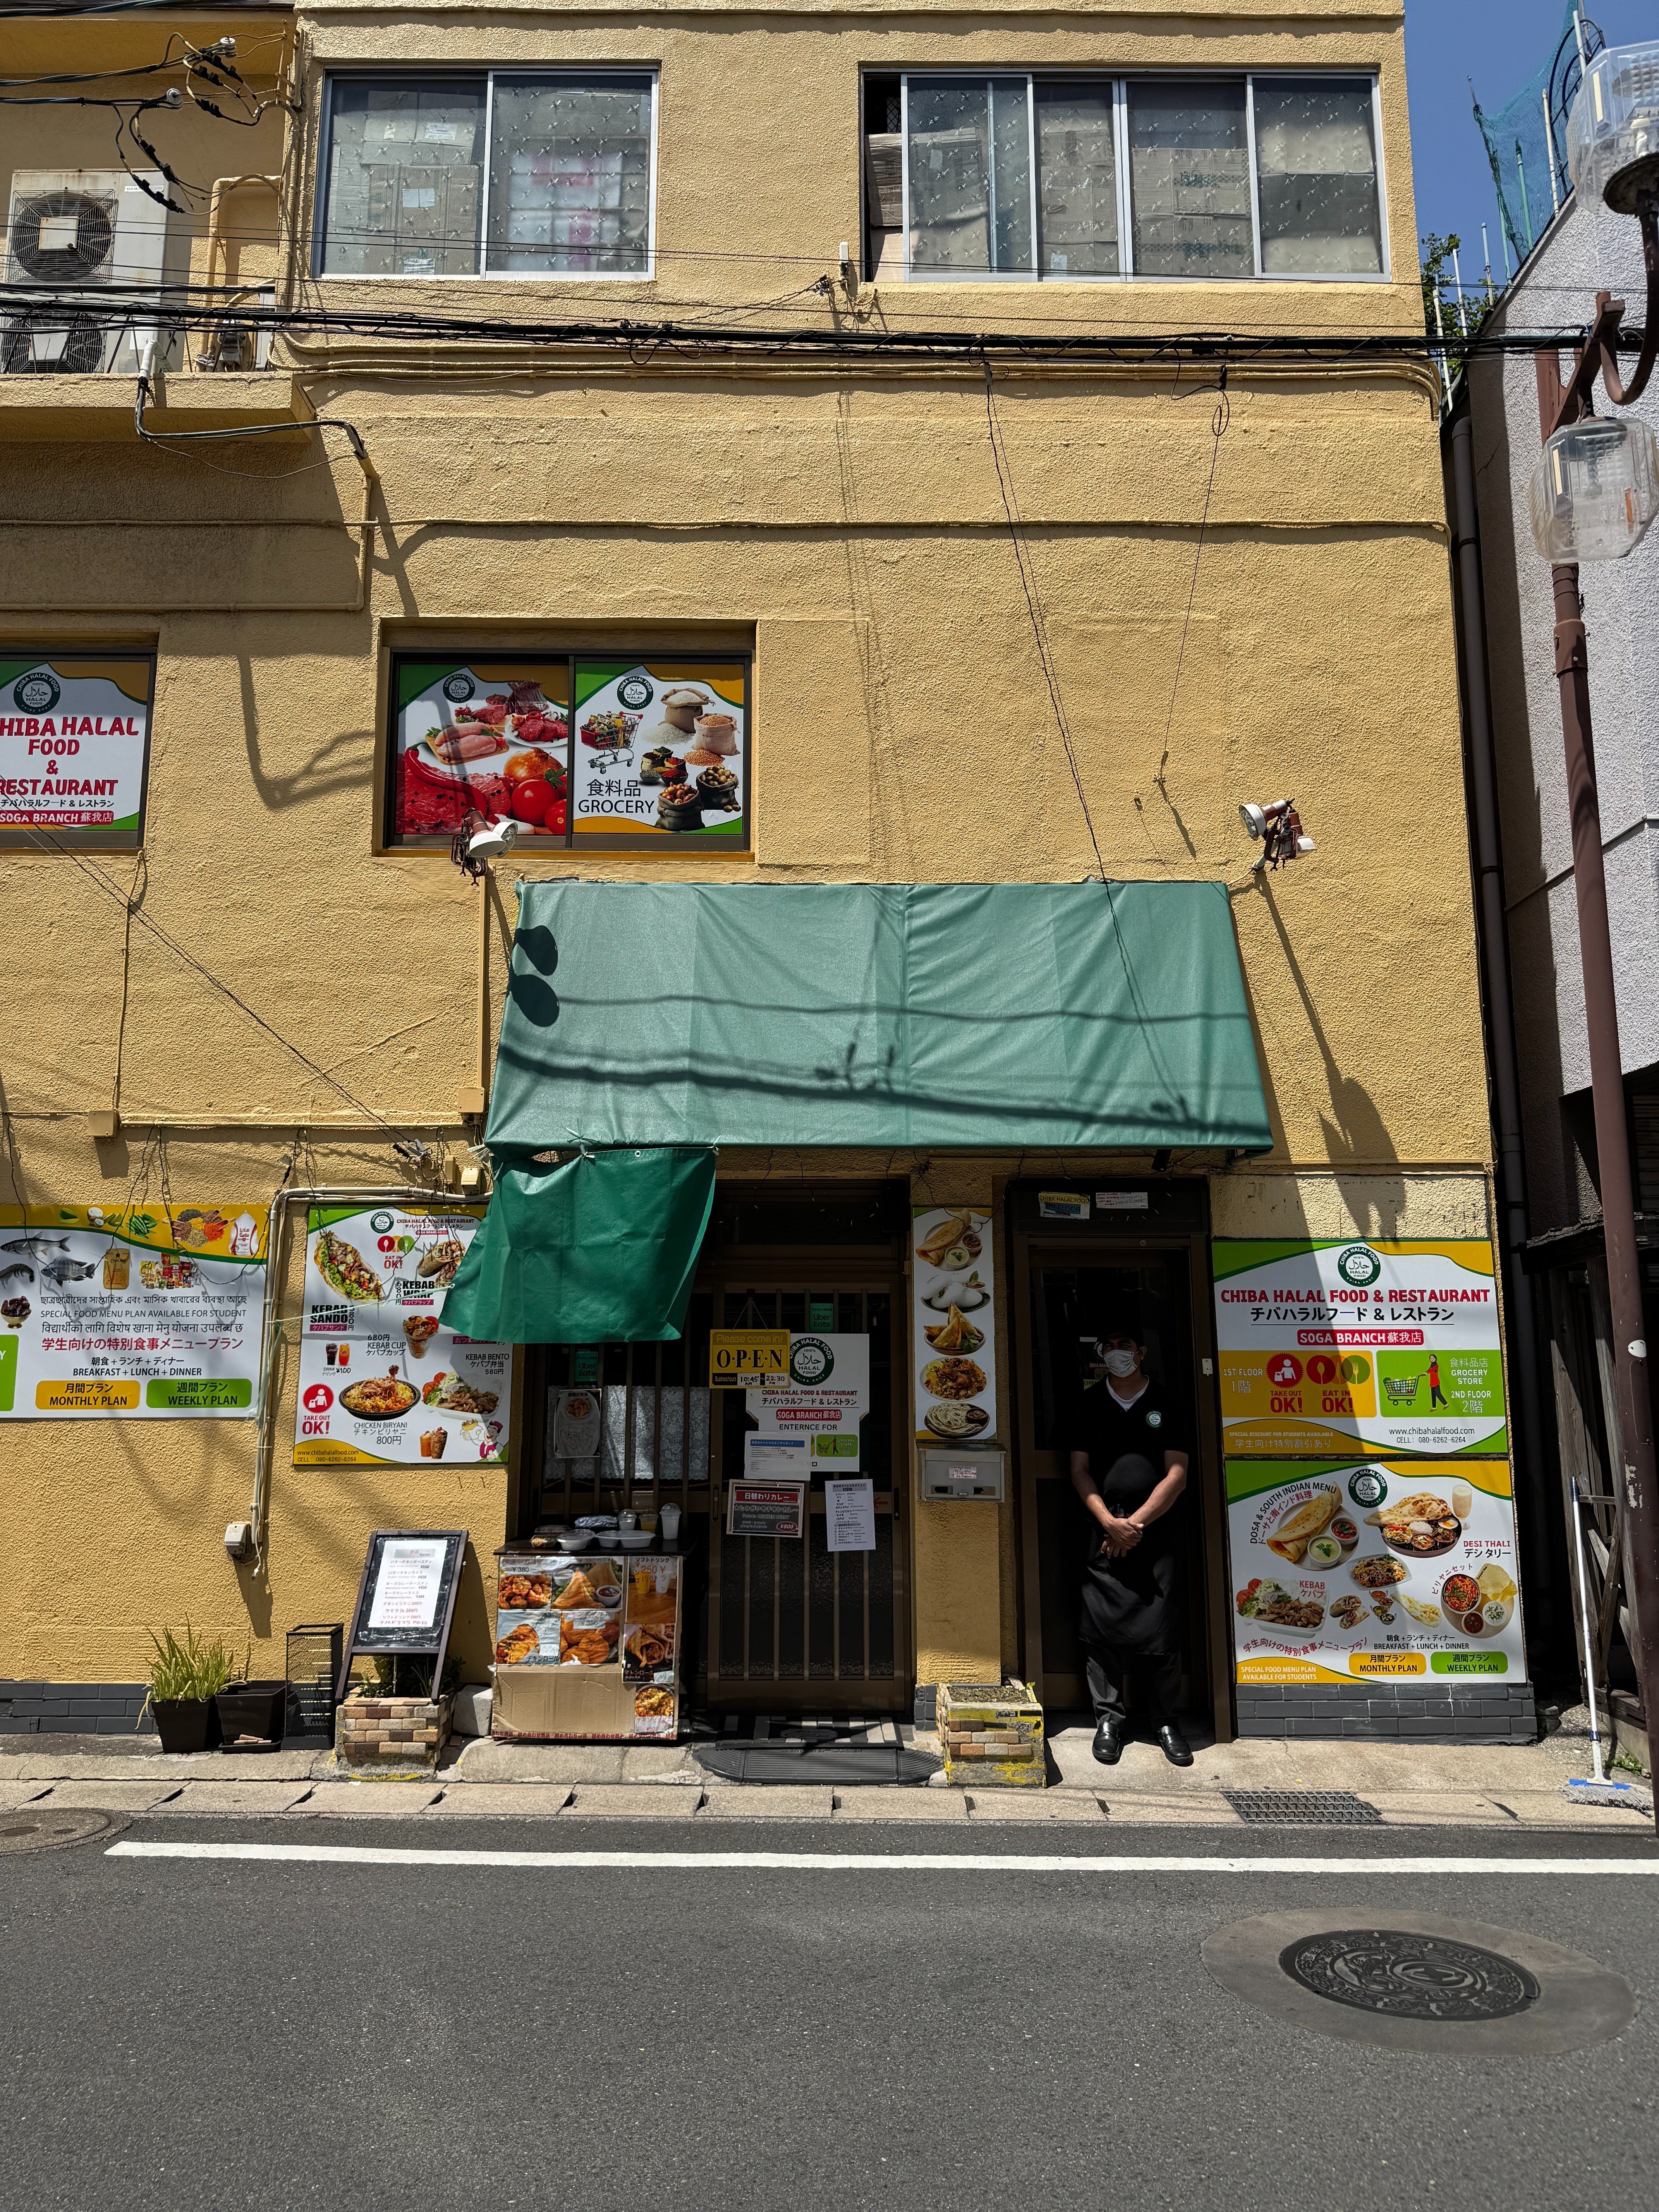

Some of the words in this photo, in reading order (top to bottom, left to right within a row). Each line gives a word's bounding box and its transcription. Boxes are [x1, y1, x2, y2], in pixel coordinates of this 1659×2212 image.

[17, 677, 30, 692] CHIBA
[49, 678, 59, 692] FOOD
[26, 686, 48, 697] حلال
[0, 718, 57, 736] HIBA
[61, 717, 139, 736] HALAL
[28, 739, 80, 755] FOOD
[46, 760, 58, 775] &
[587, 780, 641, 797] 食料品
[578, 799, 654, 814] GROCERY
[0, 814, 29, 823] SOGA
[33, 814, 78, 823] BRANCH
[80, 812, 113, 823] 蘇我店
[1058, 1205, 1080, 1213] FLOOR
[384, 1260, 403, 1269] OK!
[403, 1281, 434, 1289] KEBAB
[1221, 1290, 1269, 1303] CHIBA
[1273, 1290, 1325, 1303] HALAL
[1330, 1290, 1369, 1303] FOOD
[1373, 1290, 1384, 1303] &
[1388, 1290, 1490, 1302] RESTAURANT
[310, 1314, 348, 1323] SANDO
[1251, 1307, 1367, 1321] チバハラルフード
[1374, 1308, 1384, 1321] &
[1391, 1307, 1454, 1321] レストラン
[85, 1321, 105, 1333] लागि
[107, 1321, 131, 1333] विशेष
[132, 1324, 154, 1333] खाना
[156, 1321, 170, 1335] मेनु
[172, 1321, 199, 1333] योजना
[1300, 1333, 1333, 1343] SOGA
[1336, 1333, 1386, 1343] BRANCH
[1387, 1331, 1422, 1343] 蘇我店
[42, 1337, 243, 1350] 学生向けの特別食事メニュープラン
[91, 1357, 109, 1365] 朝食
[119, 1357, 143, 1365] ランチ
[153, 1357, 184, 1365] ディナー
[1450, 1358, 1487, 1367] 食料品店
[65, 1382, 113, 1393] 月間プラン
[177, 1382, 228, 1393] 週間プラン
[1231, 1380, 1251, 1393] 1階
[50, 1396, 99, 1405] MONTHLY
[101, 1396, 127, 1405] PLAN
[168, 1396, 208, 1405] WEEKLY
[211, 1395, 237, 1405] PLAN
[1270, 1397, 1302, 1413] OK!
[1322, 1397, 1353, 1413] OK!
[1462, 1400, 1483, 1413] 2階
[302, 1421, 330, 1434] OK!
[376, 1436, 401, 1444] 800円
[1235, 1439, 1331, 1448] 学生向け特別割引あり
[1250, 1522, 1261, 1544] DOSA
[1260, 1491, 1283, 1514] SOUTH
[1282, 1482, 1310, 1496] INDIAN
[1312, 1482, 1336, 1494] MENU
[1300, 1580, 1325, 1589] KEBAB
[1301, 1589, 1324, 1598] ケバブ
[1243, 1637, 1367, 1656] 学生向けの特別食事メニュープラン
[1370, 1655, 1405, 1663] 月間プラン
[1452, 1654, 1489, 1662] 週間プラン
